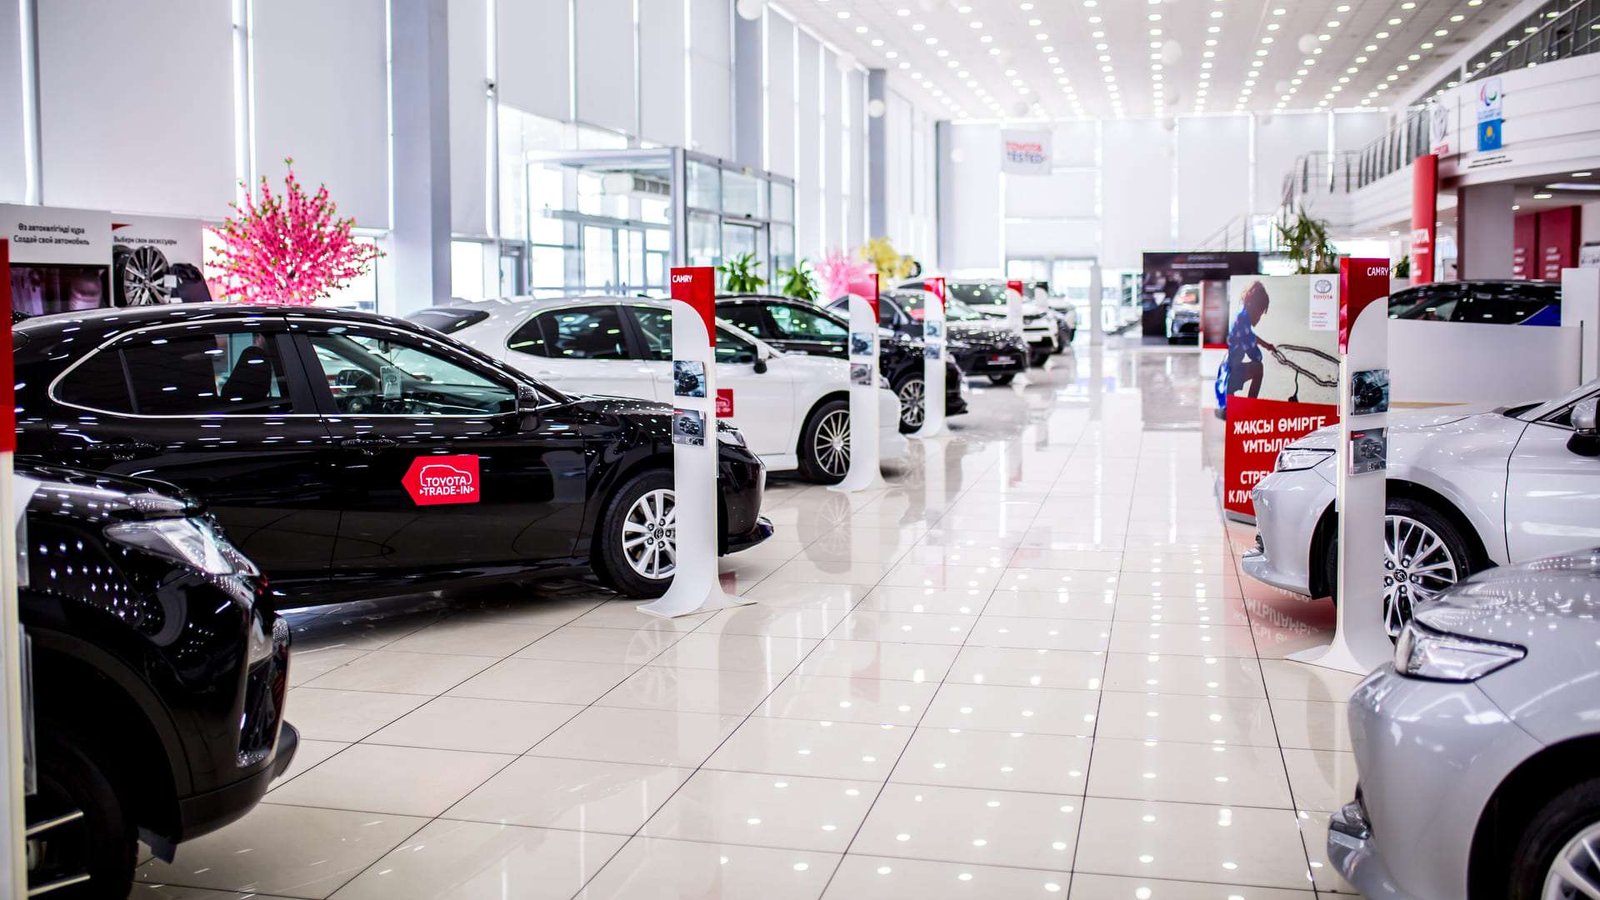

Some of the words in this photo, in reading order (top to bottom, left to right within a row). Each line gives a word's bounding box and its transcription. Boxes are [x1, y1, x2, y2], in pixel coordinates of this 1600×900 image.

[1367, 266, 1389, 277] CAMRY
[672, 274, 693, 283] CAMRY
[1233, 419, 1274, 435] ЖАҚСЫ
[1277, 416, 1326, 433] ӨМІРГЕ
[425, 476, 467, 487] TOYOTA
[423, 486, 470, 496] TRADE-IN
